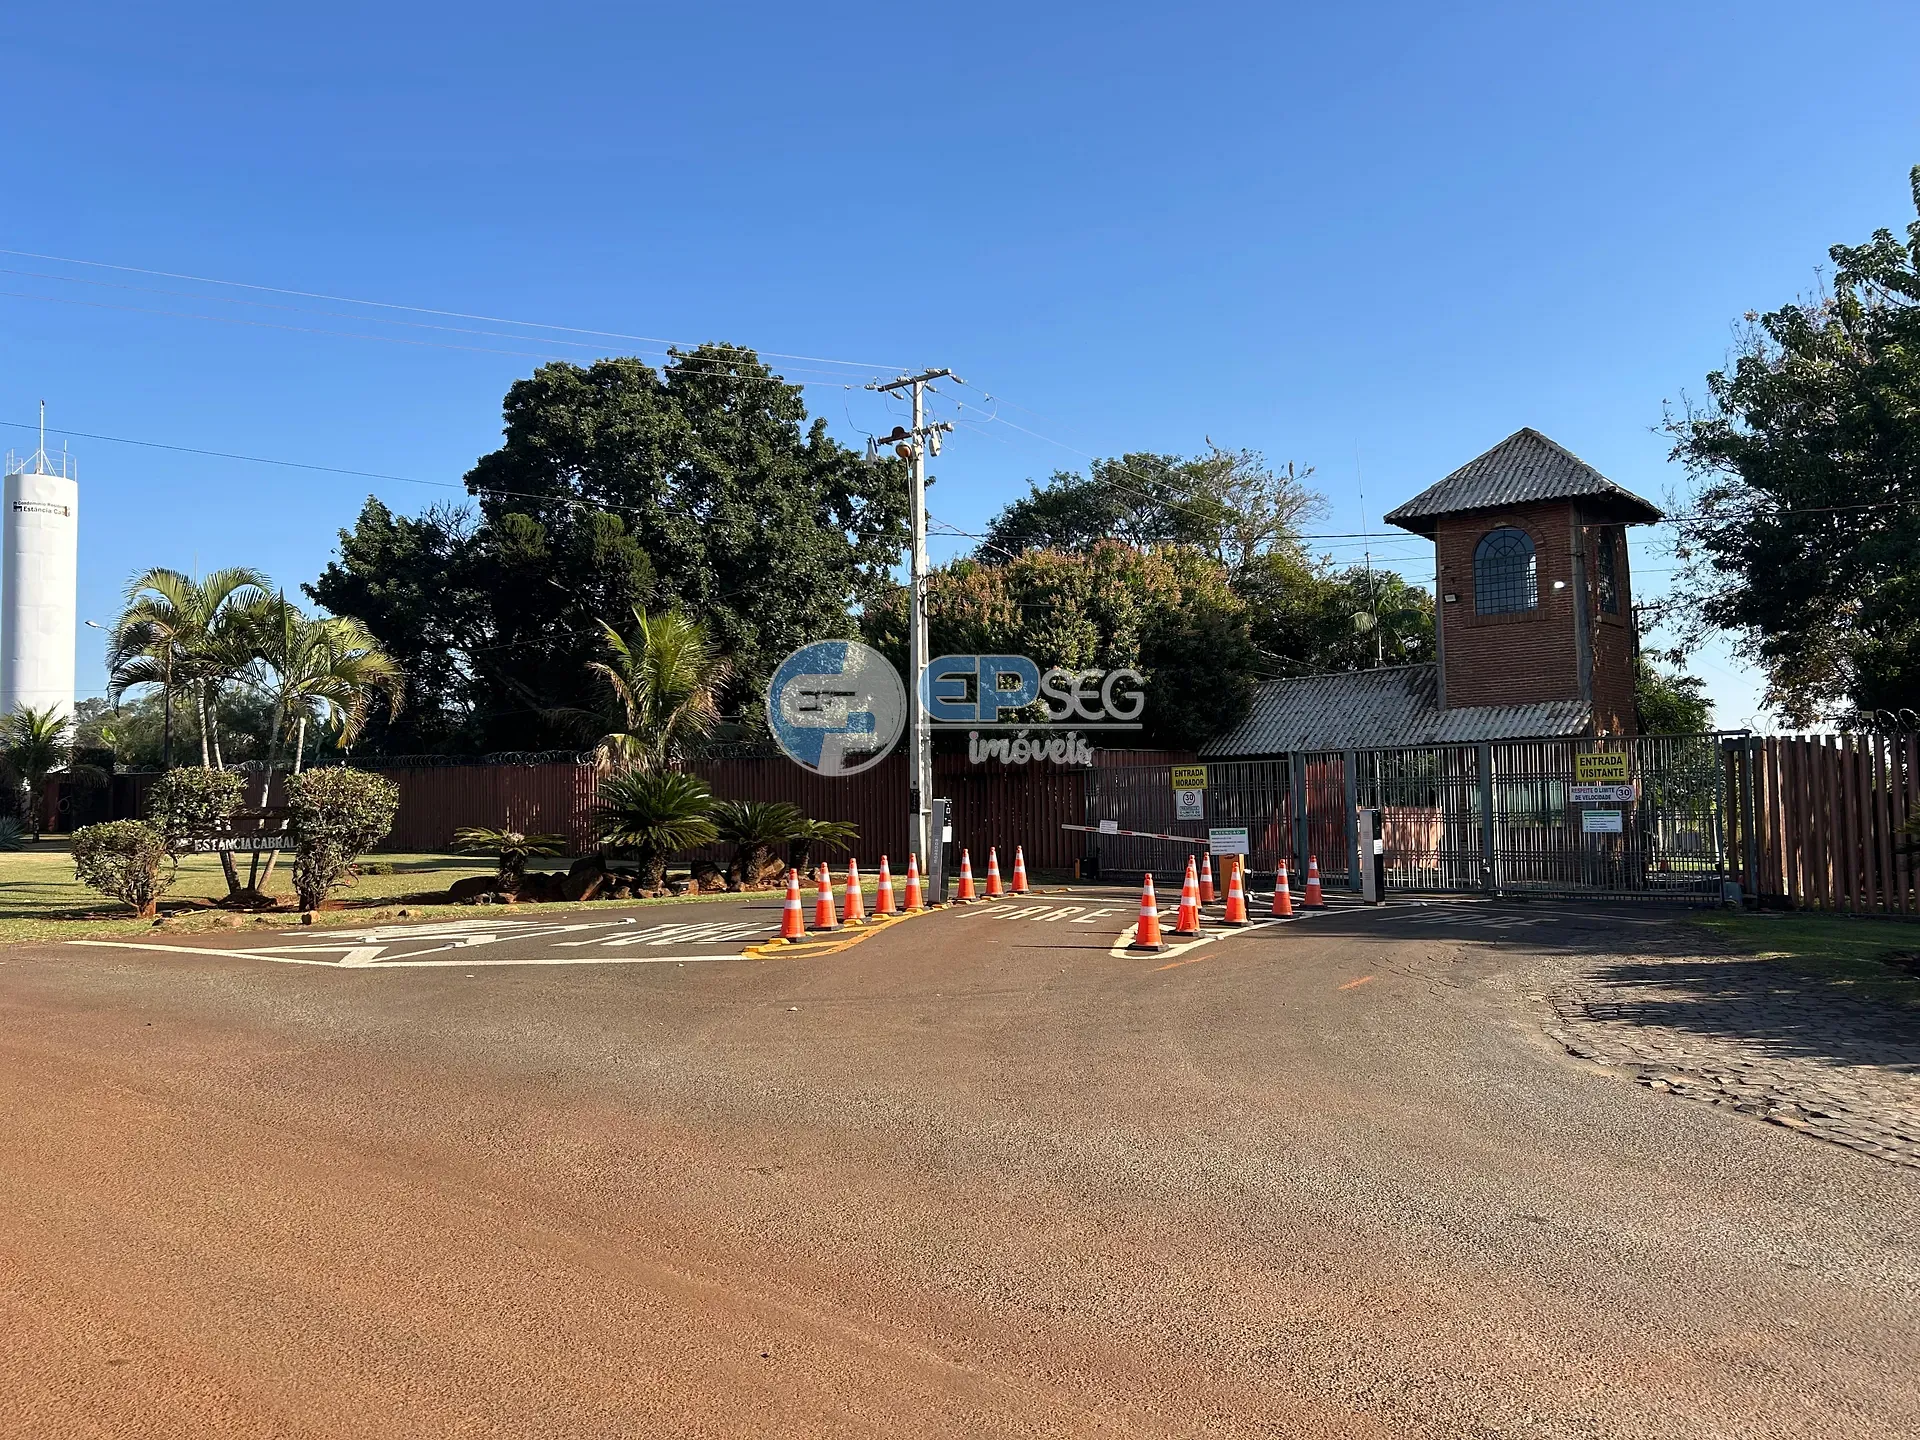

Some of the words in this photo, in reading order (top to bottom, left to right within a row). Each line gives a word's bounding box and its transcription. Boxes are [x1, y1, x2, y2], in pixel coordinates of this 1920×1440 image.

[1580, 756, 1623, 766] ENTRADA
[1174, 769, 1204, 777] ENTRADA
[1580, 768, 1625, 778] VISITANTE
[1175, 779, 1205, 787] MORADOR
[252, 836, 297, 849] CABRAL
[955, 904, 1127, 924] PARE
[1376, 911, 1560, 929] PARE
